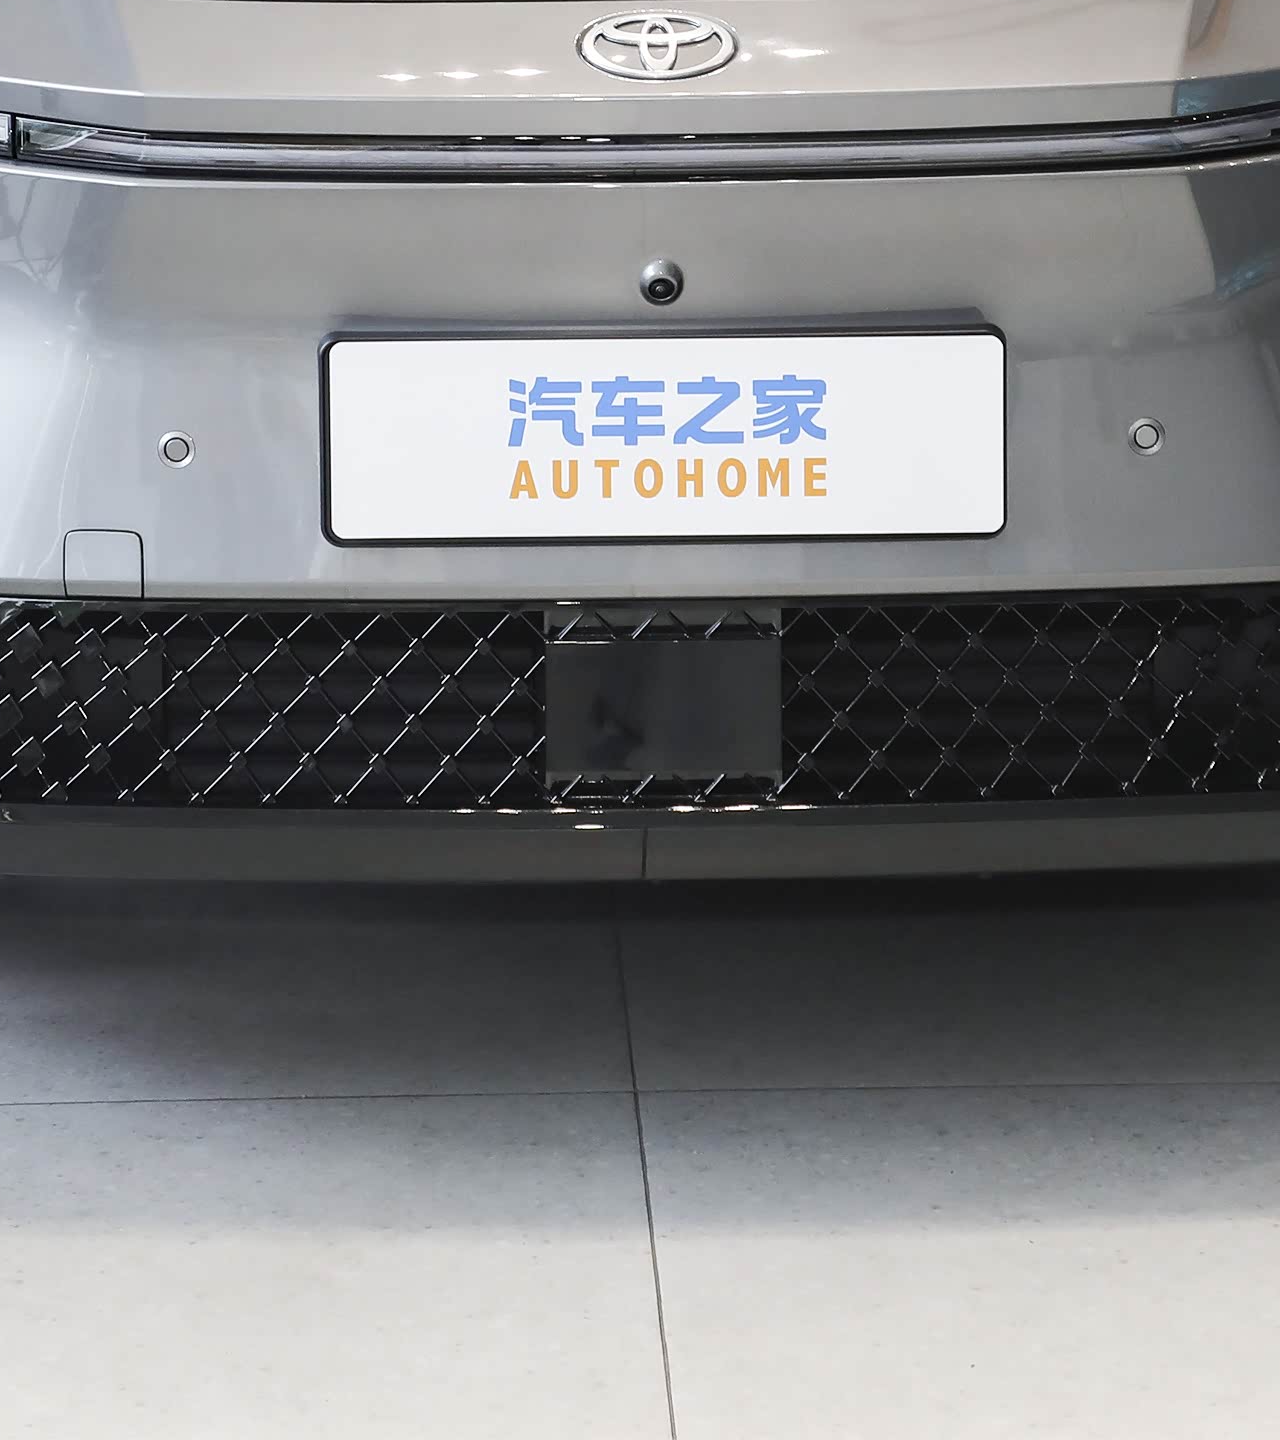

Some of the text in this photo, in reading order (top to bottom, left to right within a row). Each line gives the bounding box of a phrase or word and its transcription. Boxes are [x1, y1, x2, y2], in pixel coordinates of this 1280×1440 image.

[508, 374, 827, 448] 汽车之家
[511, 457, 828, 500] AUTOHOME
